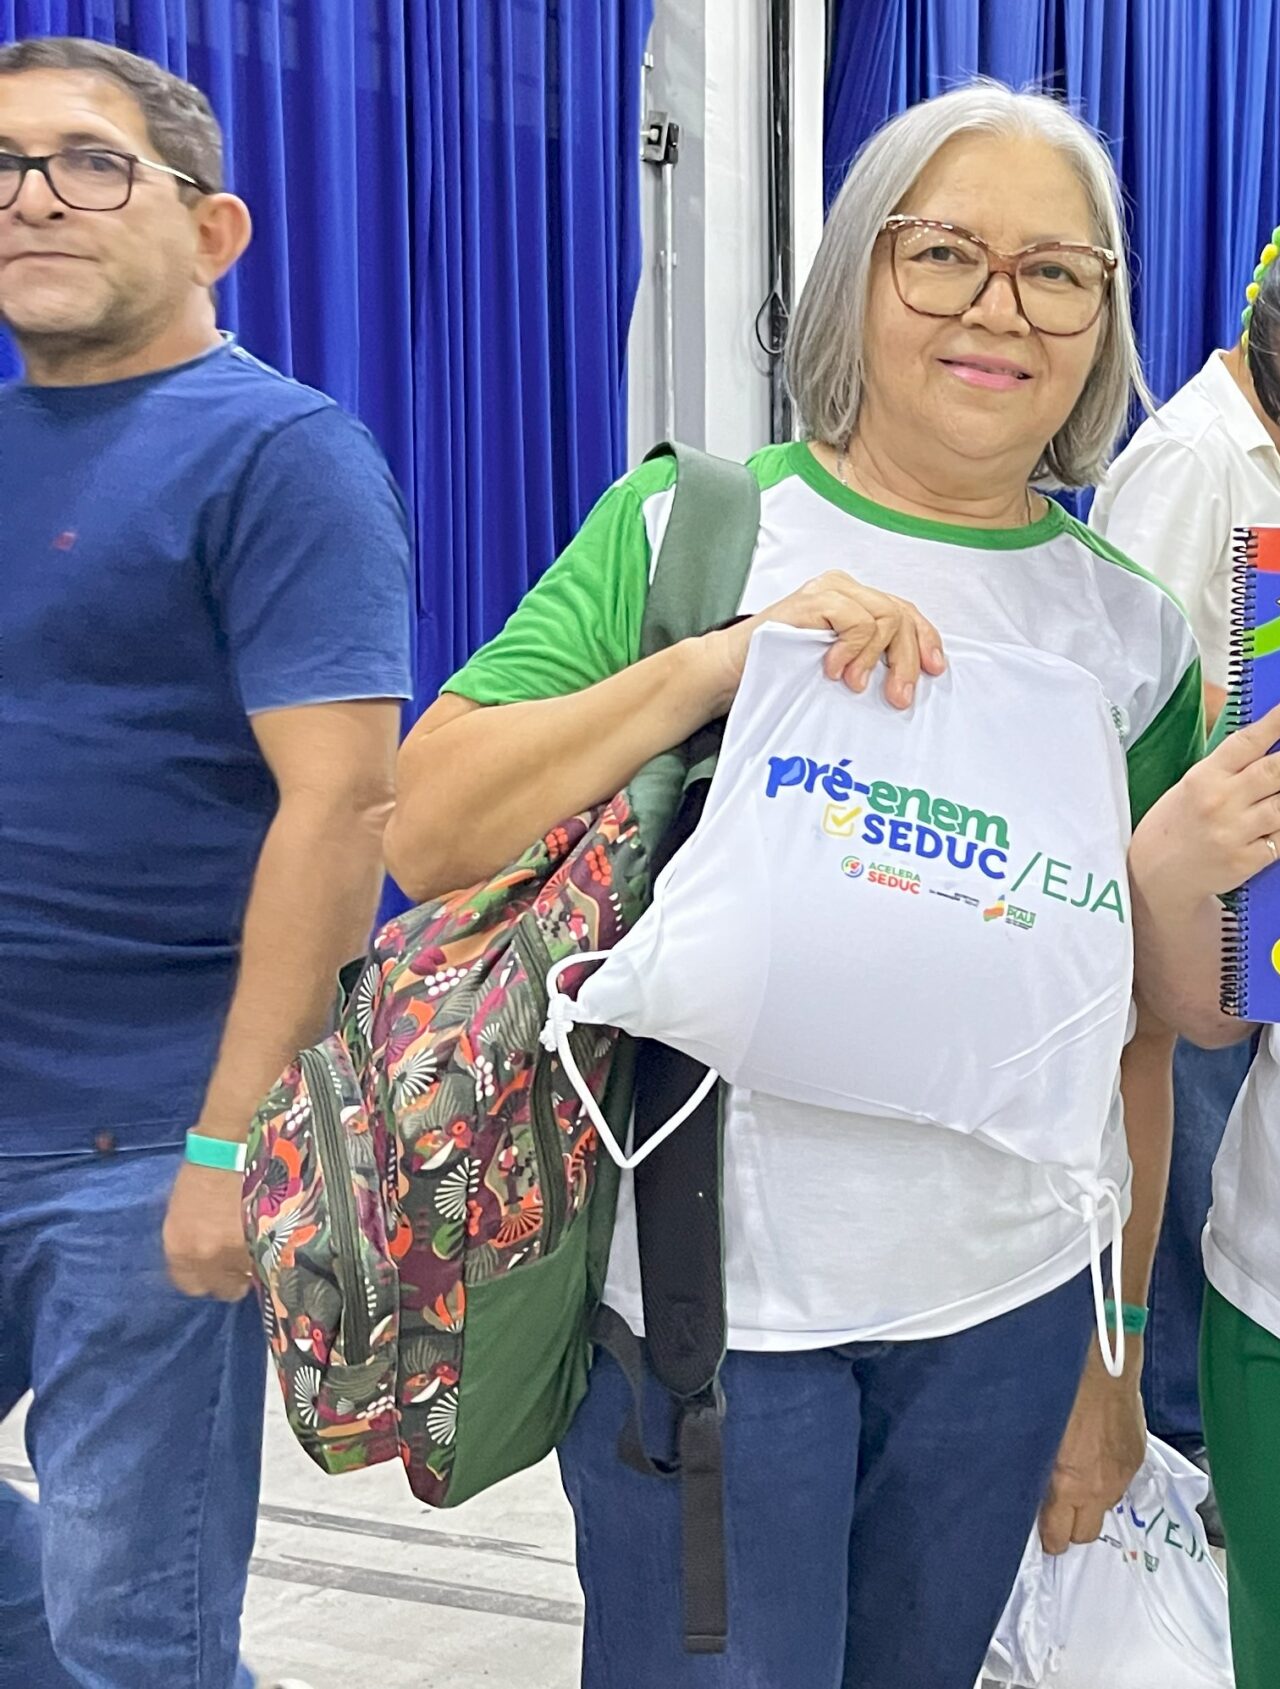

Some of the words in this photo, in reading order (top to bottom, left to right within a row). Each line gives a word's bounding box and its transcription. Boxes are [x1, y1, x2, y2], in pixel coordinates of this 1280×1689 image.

[765, 756, 1010, 850] pré-enem
[861, 813, 1008, 880] SEDUC
[868, 862, 921, 882] ACELERA
[867, 871, 921, 894] SEDUC
[1010, 851, 1125, 923] /EJA
